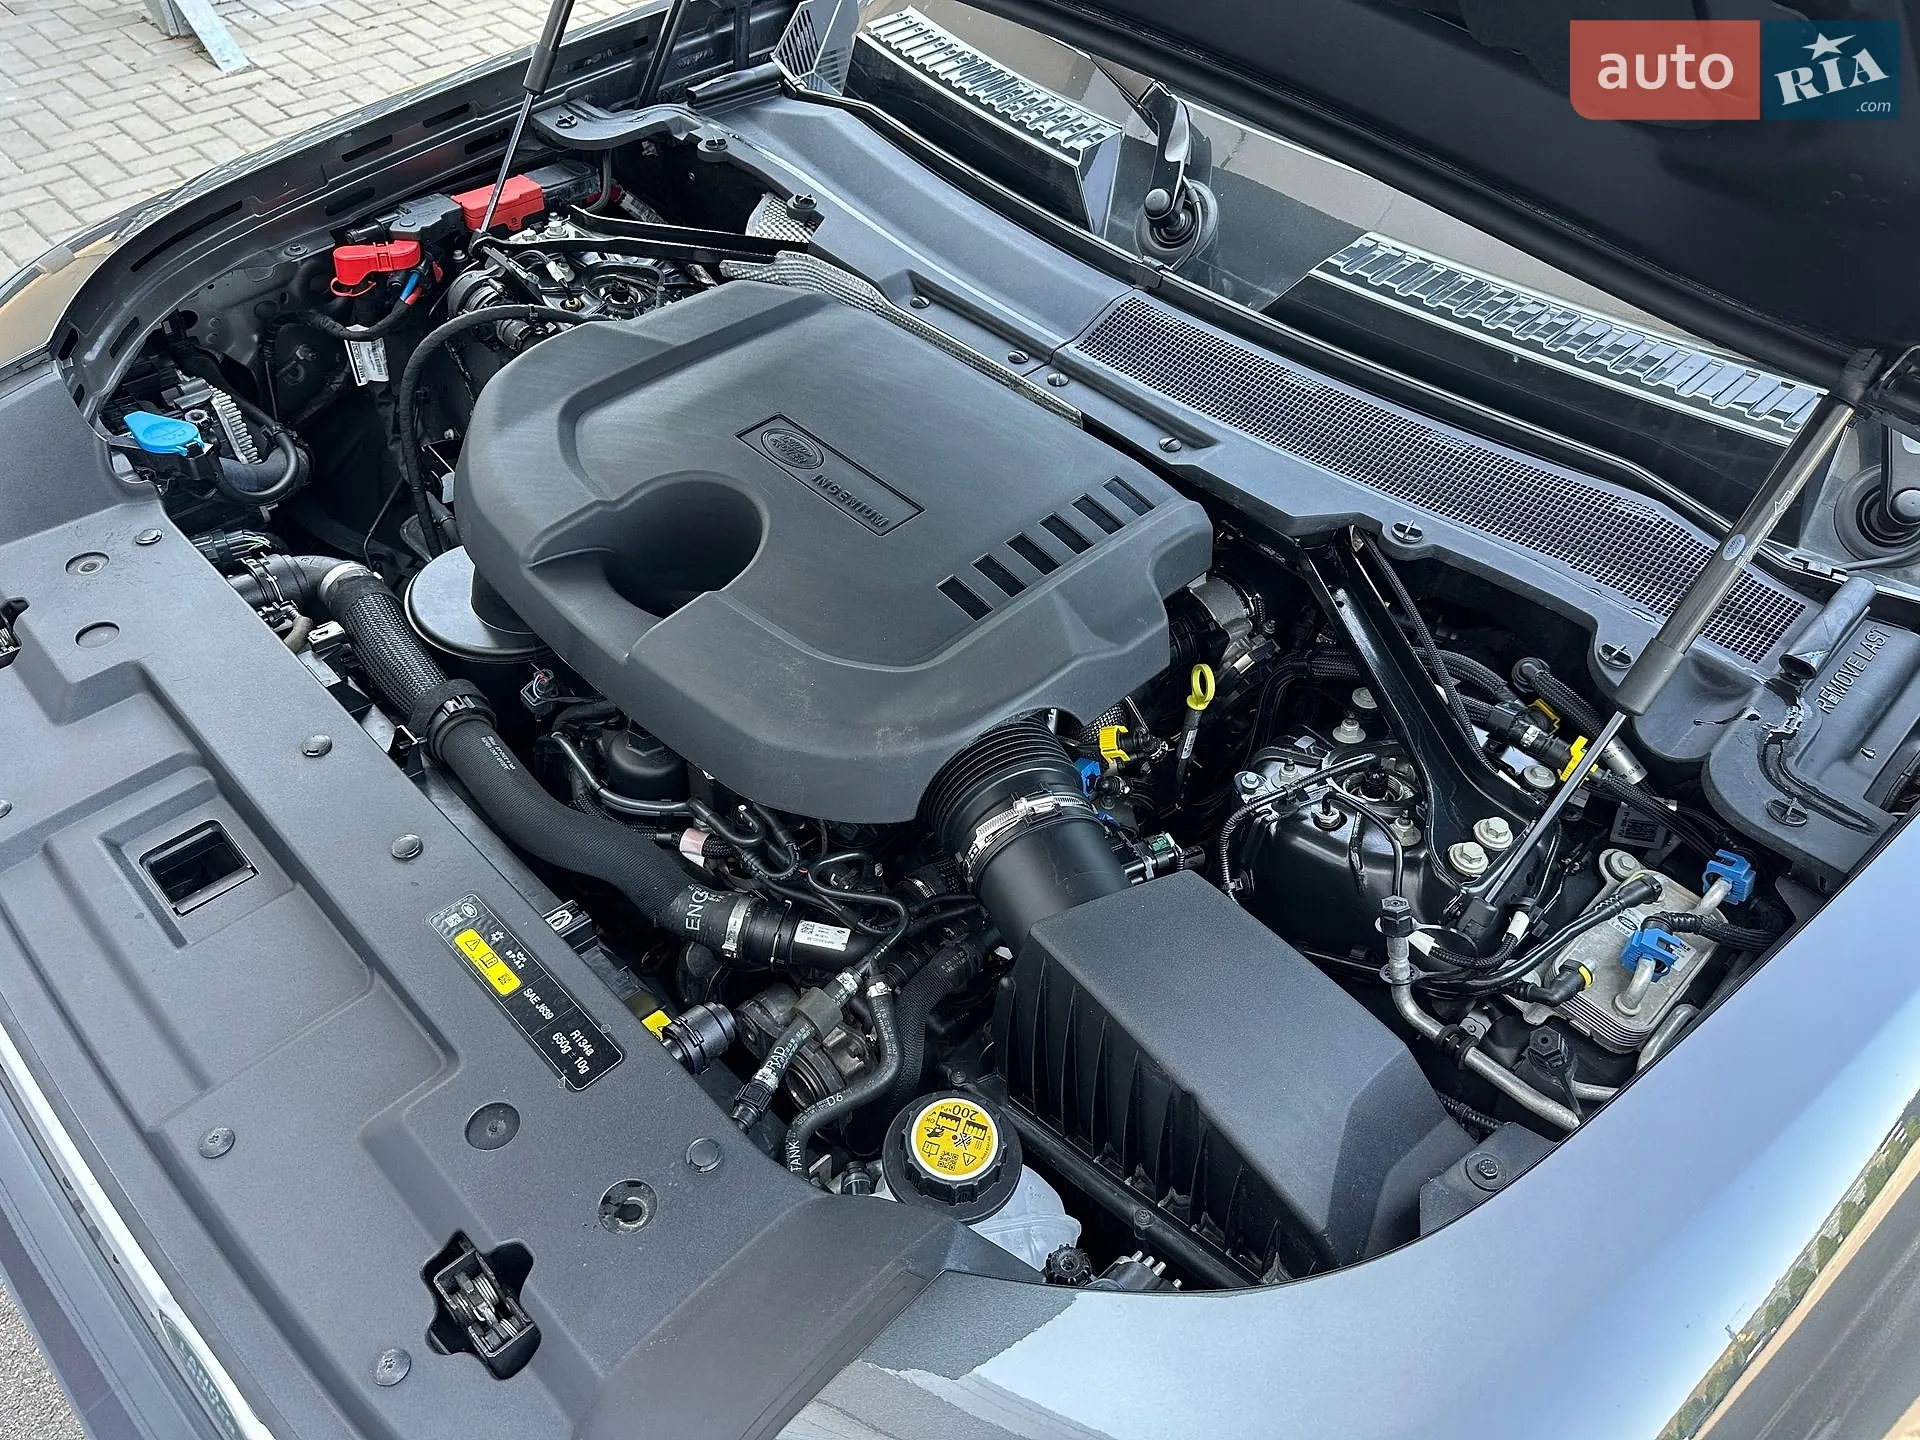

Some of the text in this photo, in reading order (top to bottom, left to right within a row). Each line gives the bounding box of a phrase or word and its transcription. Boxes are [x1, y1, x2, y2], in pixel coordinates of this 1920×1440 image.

[811, 473, 891, 528] INGENIUM
[1815, 627, 1891, 715] REMOVE LAST
[523, 987, 554, 1020] SAE J639
[551, 1031, 572, 1054] 650g
[573, 1056, 590, 1075] 10g
[569, 1028, 595, 1057] R134a
[790, 1092, 843, 1172] TANK D6
[952, 1104, 979, 1121] 200
